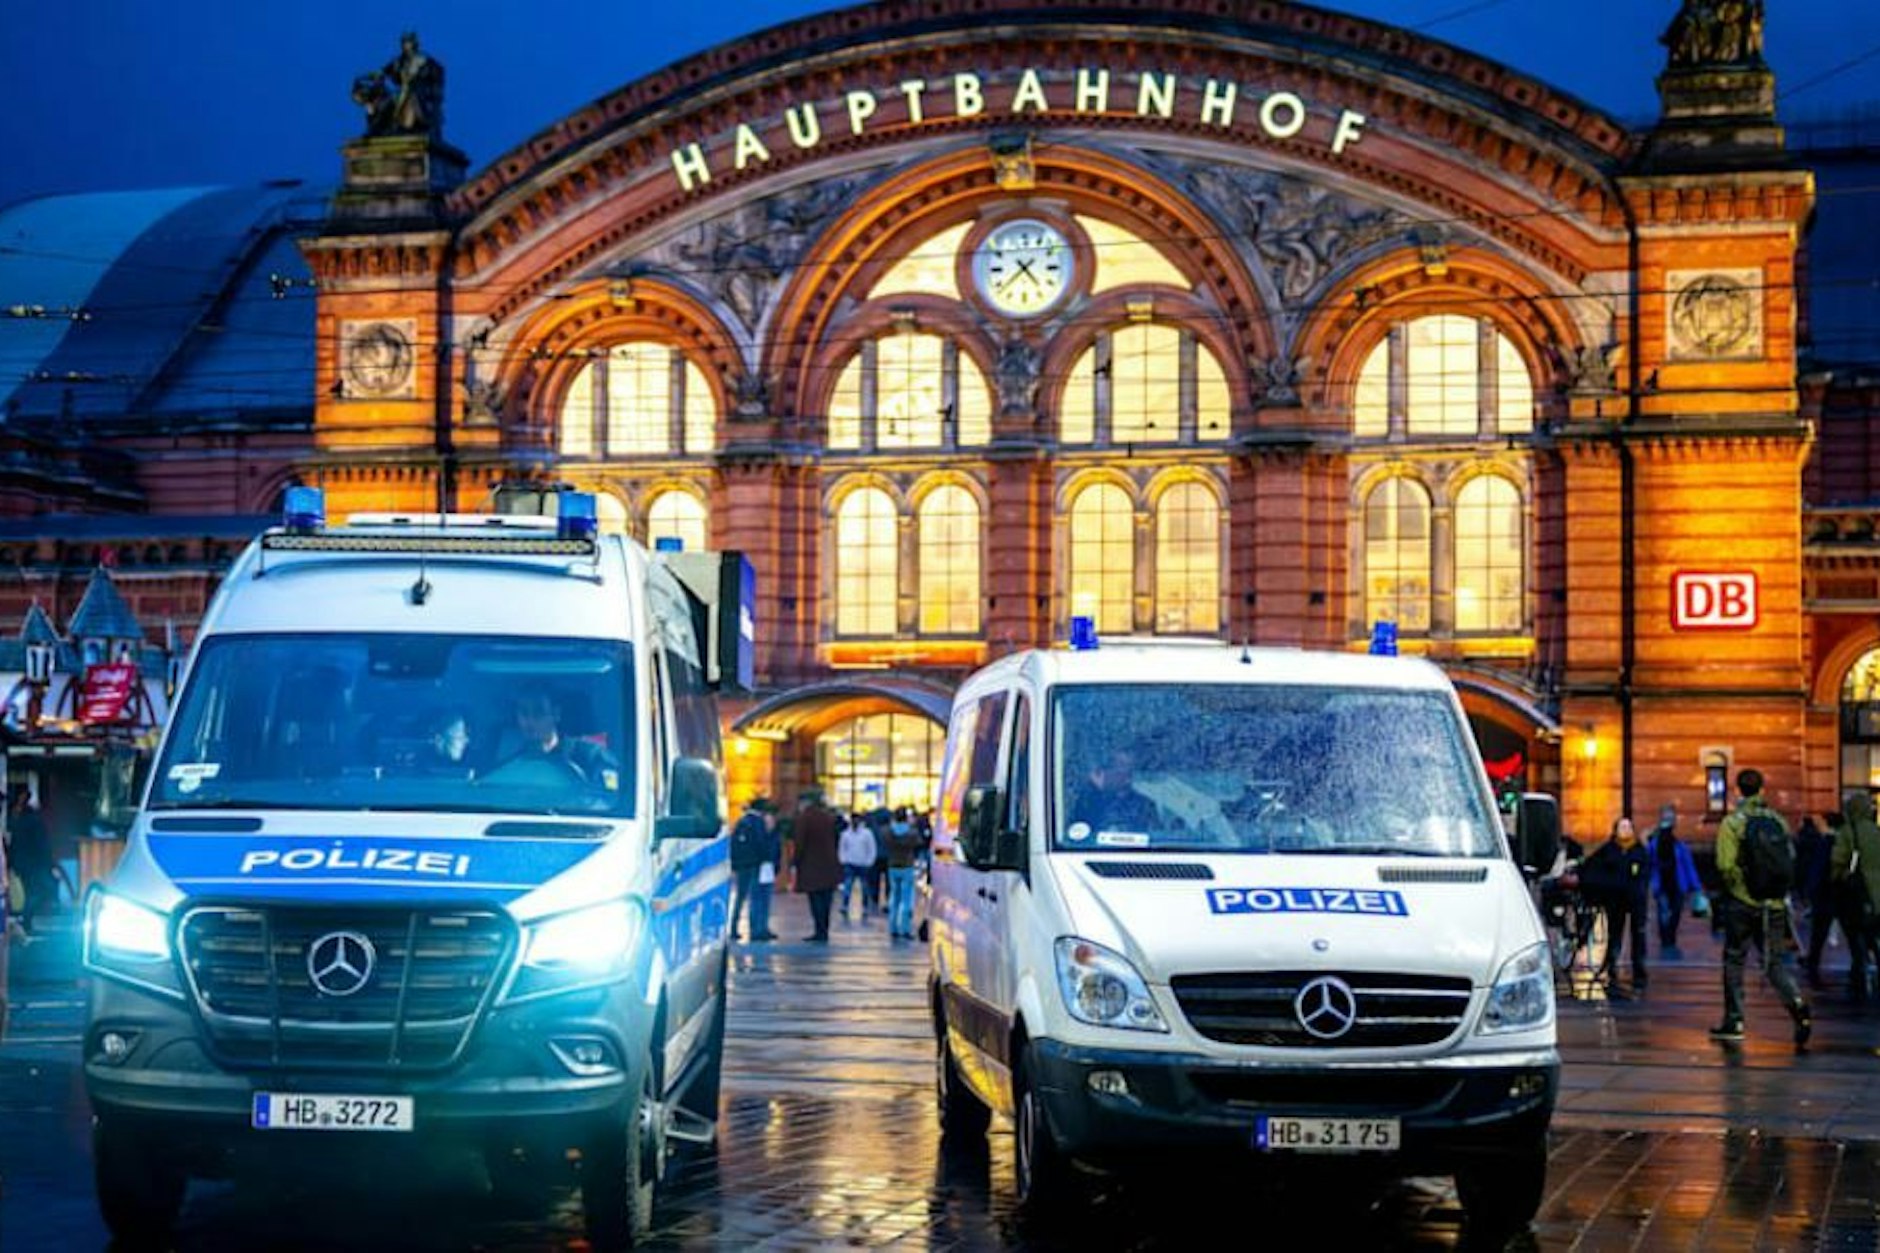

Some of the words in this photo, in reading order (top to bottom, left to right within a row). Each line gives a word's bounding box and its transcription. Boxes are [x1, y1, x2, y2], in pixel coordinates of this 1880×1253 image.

[669, 67, 1367, 191] HAUPTBAHNHOF
[1684, 581, 1749, 618] DB
[240, 847, 471, 876] POLIZEI
[1213, 889, 1400, 914] POLIZEI
[335, 1101, 398, 1126] 3272
